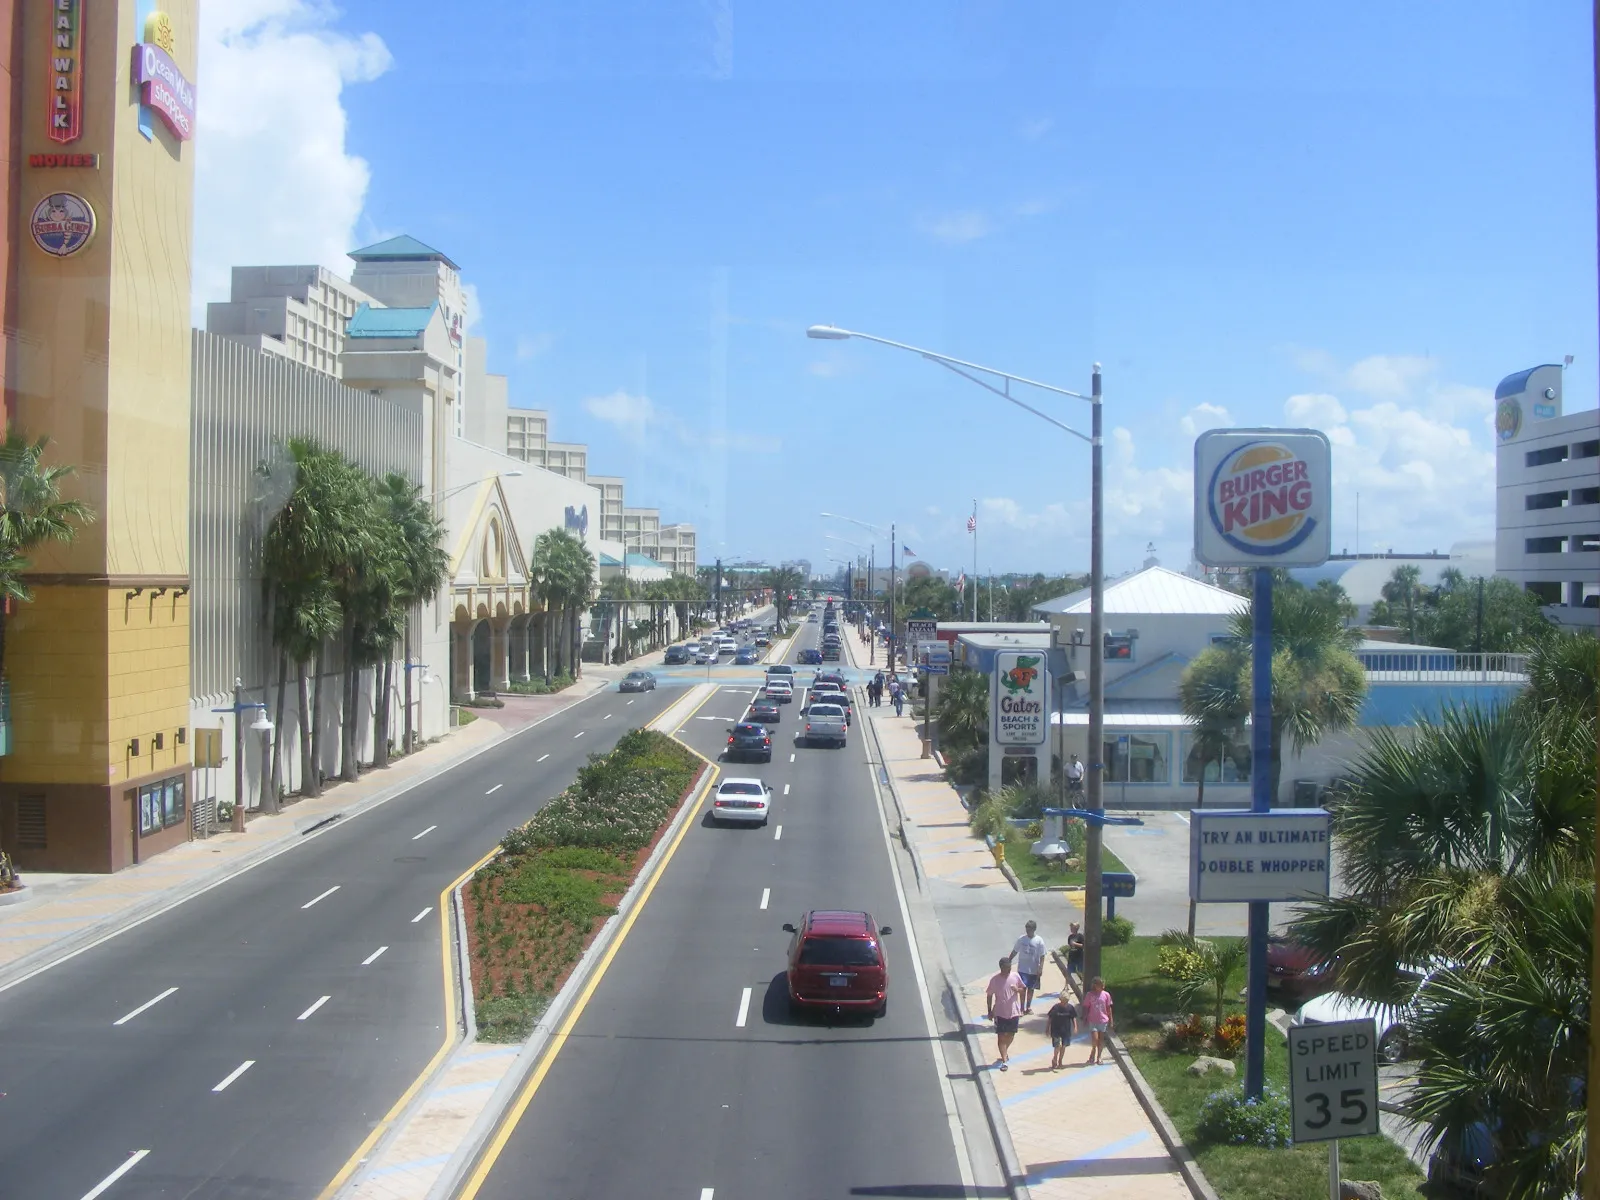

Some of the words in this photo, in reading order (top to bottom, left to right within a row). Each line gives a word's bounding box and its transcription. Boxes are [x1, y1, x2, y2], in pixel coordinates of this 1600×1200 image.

[145, 46, 176, 90] Ocean
[174, 70, 195, 112] Walk
[54, 58, 71, 128] WALK
[154, 83, 189, 132] shoppes
[29, 154, 93, 168] MOVIES
[1220, 460, 1309, 503] BURGER
[1224, 480, 1312, 533] KING
[1001, 696, 1041, 714] Gator
[1001, 715, 1031, 723] BEACH
[1033, 715, 1040, 723] &
[1203, 831, 1229, 844] TRY
[1234, 831, 1253, 844] AN
[1259, 830, 1326, 844] ULTIMATE
[1261, 859, 1325, 872] WHOPPER
[1297, 1033, 1369, 1056] SPEED
[1306, 1061, 1361, 1082] LIMIT
[1304, 1089, 1368, 1130] 35
